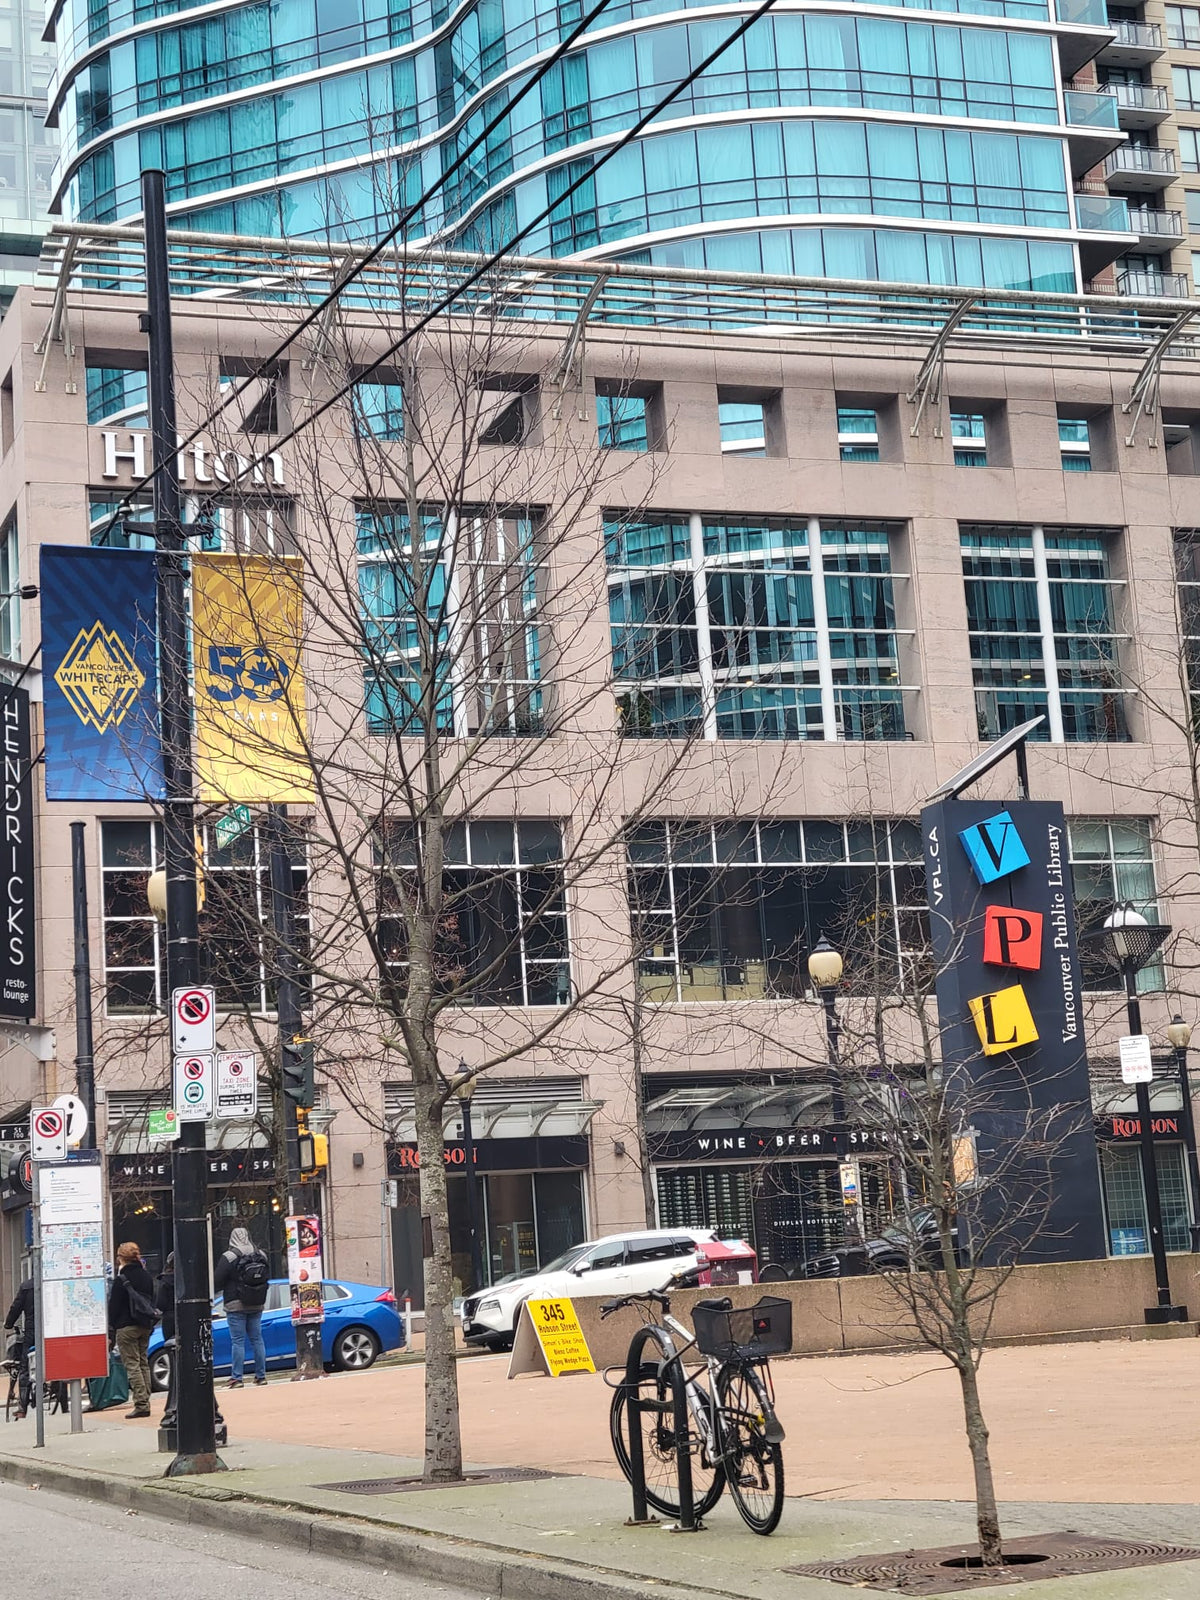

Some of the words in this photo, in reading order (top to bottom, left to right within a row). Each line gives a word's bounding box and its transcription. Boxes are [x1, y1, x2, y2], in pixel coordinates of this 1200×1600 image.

[102, 431, 286, 486] Hlton
[60, 671, 139, 685] WHITECAPS
[92, 685, 107, 696] FC
[4, 695, 24, 966] HENDRICKS
[1046, 824, 1063, 887] Library
[929, 826, 944, 906] VPL.CA
[1051, 893, 1069, 949] Public
[5, 978, 28, 989] resto-
[3, 987, 29, 1004] lounge
[1060, 954, 1077, 1043] Vancouver
[698, 1137, 746, 1150] WINE
[123, 1165, 165, 1175] WINE
[540, 1303, 565, 1321] 345
[538, 1324, 560, 1333] Robson
[560, 1322, 578, 1332] Street
